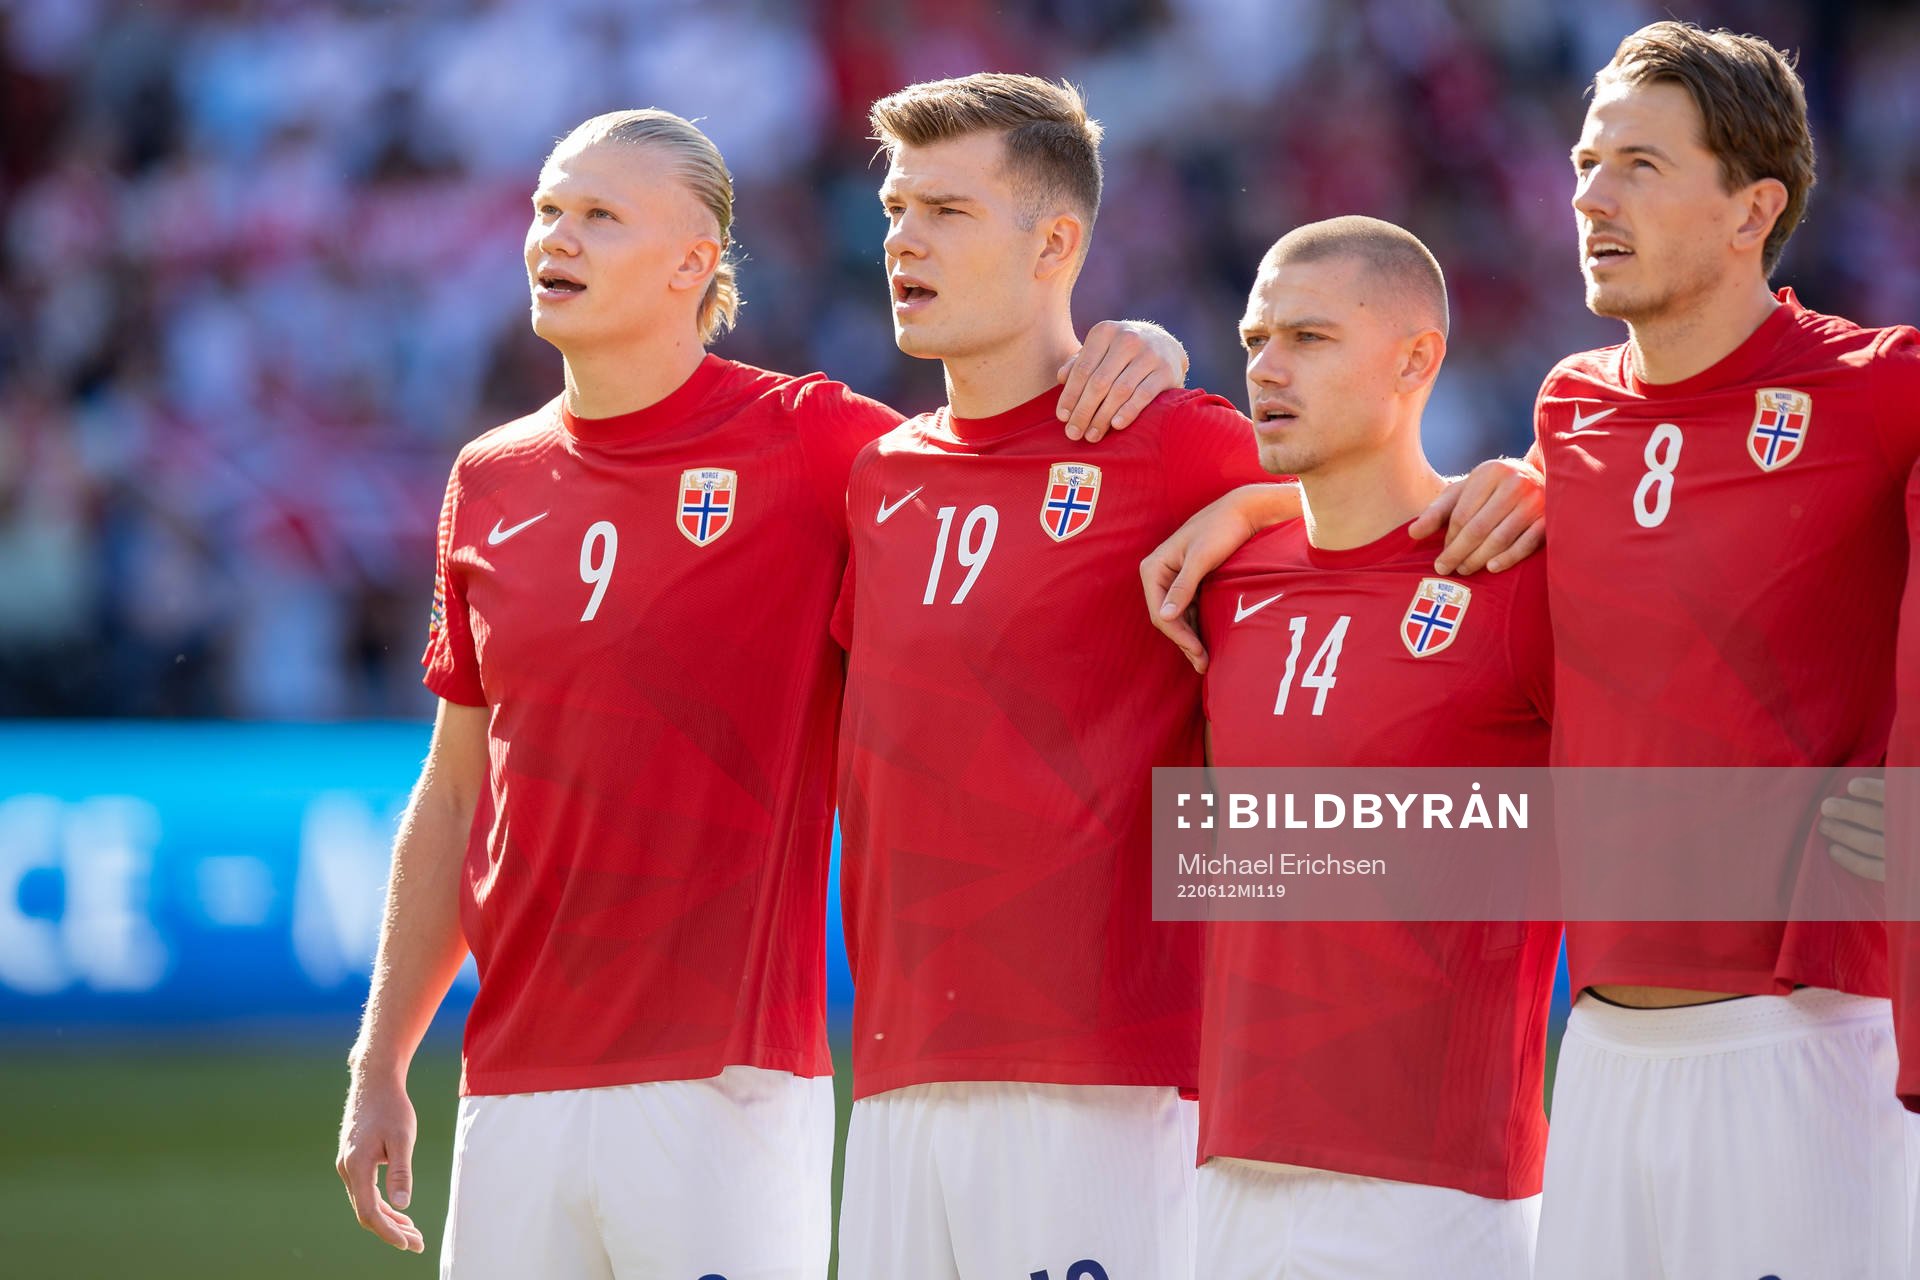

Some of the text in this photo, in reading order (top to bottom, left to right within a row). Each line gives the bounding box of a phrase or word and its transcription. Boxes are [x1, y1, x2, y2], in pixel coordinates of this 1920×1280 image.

[701, 471, 720, 479] NORGE
[1067, 465, 1084, 474] NORGE
[1632, 423, 1684, 528] 8
[579, 521, 618, 622] 9
[922, 504, 999, 605] 19
[1273, 615, 1352, 716] 14
